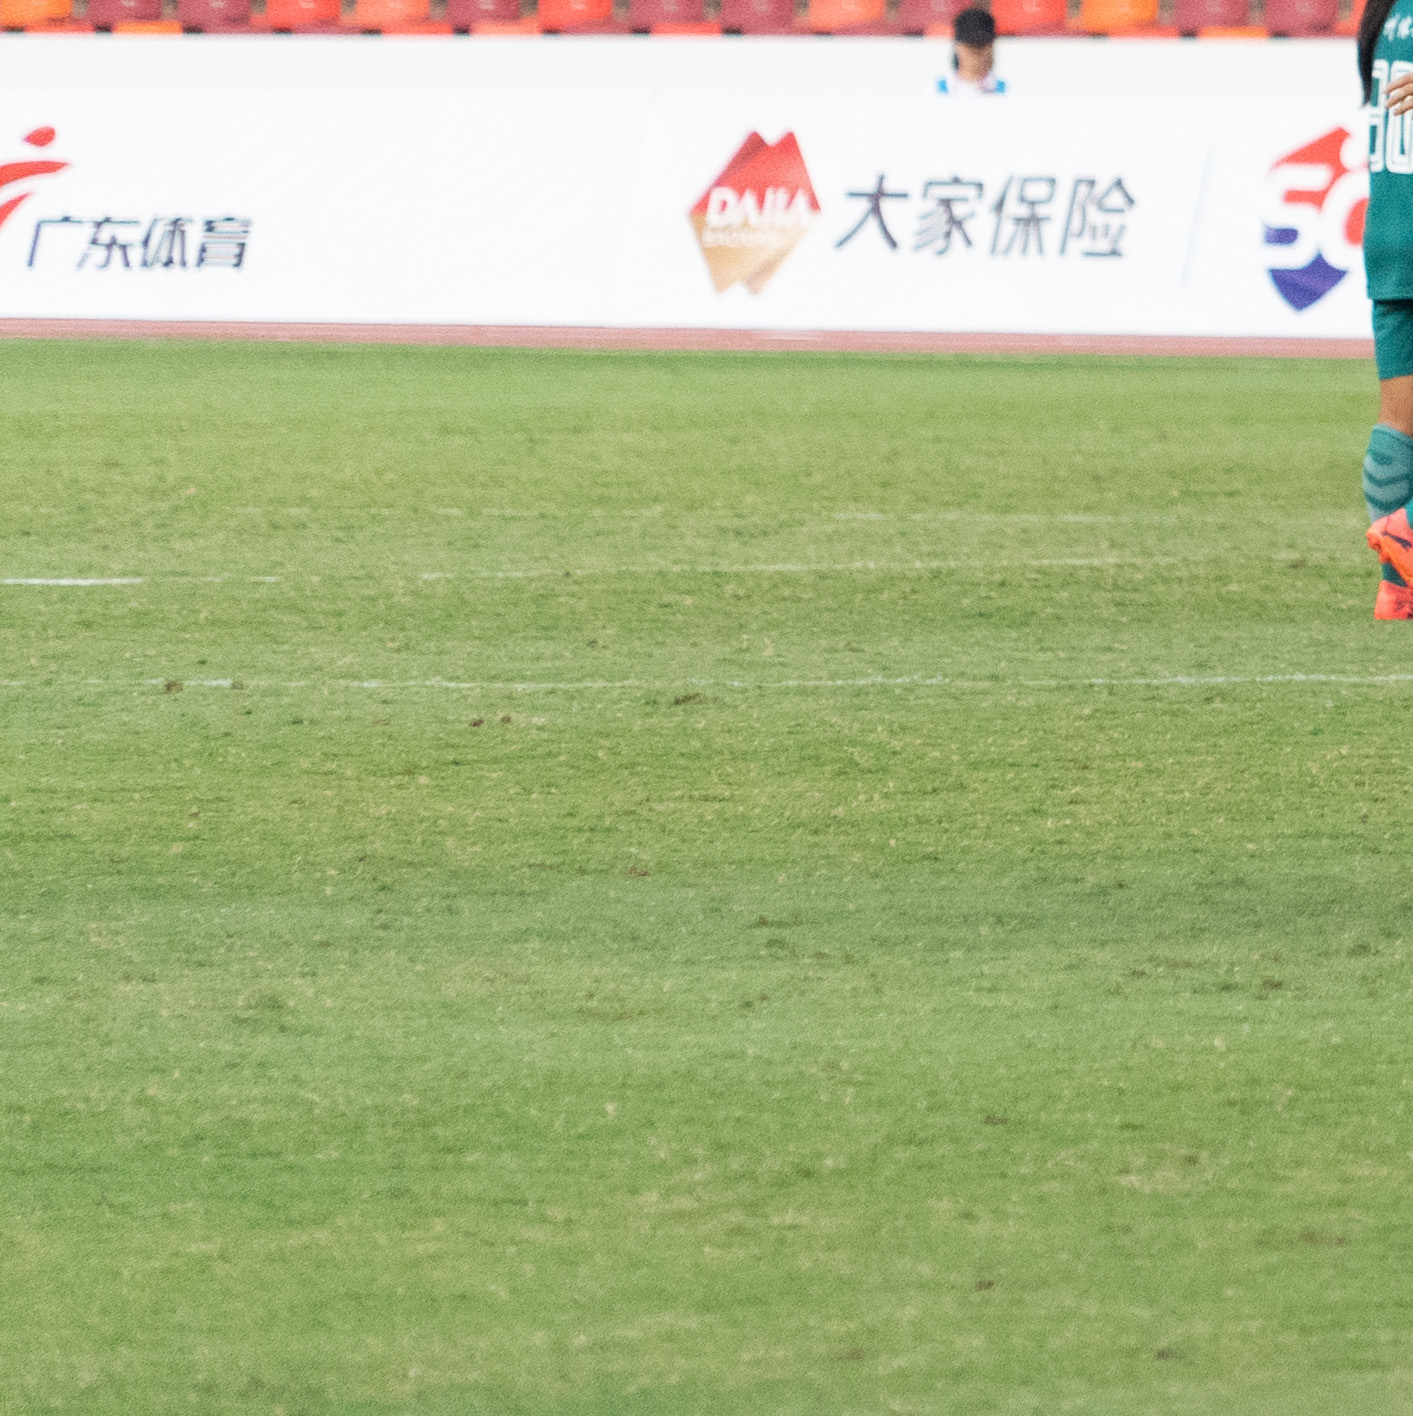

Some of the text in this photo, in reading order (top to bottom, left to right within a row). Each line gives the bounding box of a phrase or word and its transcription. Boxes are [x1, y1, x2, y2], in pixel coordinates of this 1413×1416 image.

[26, 214, 252, 271] 广东体育
[834, 173, 1136, 259] 大家保险
